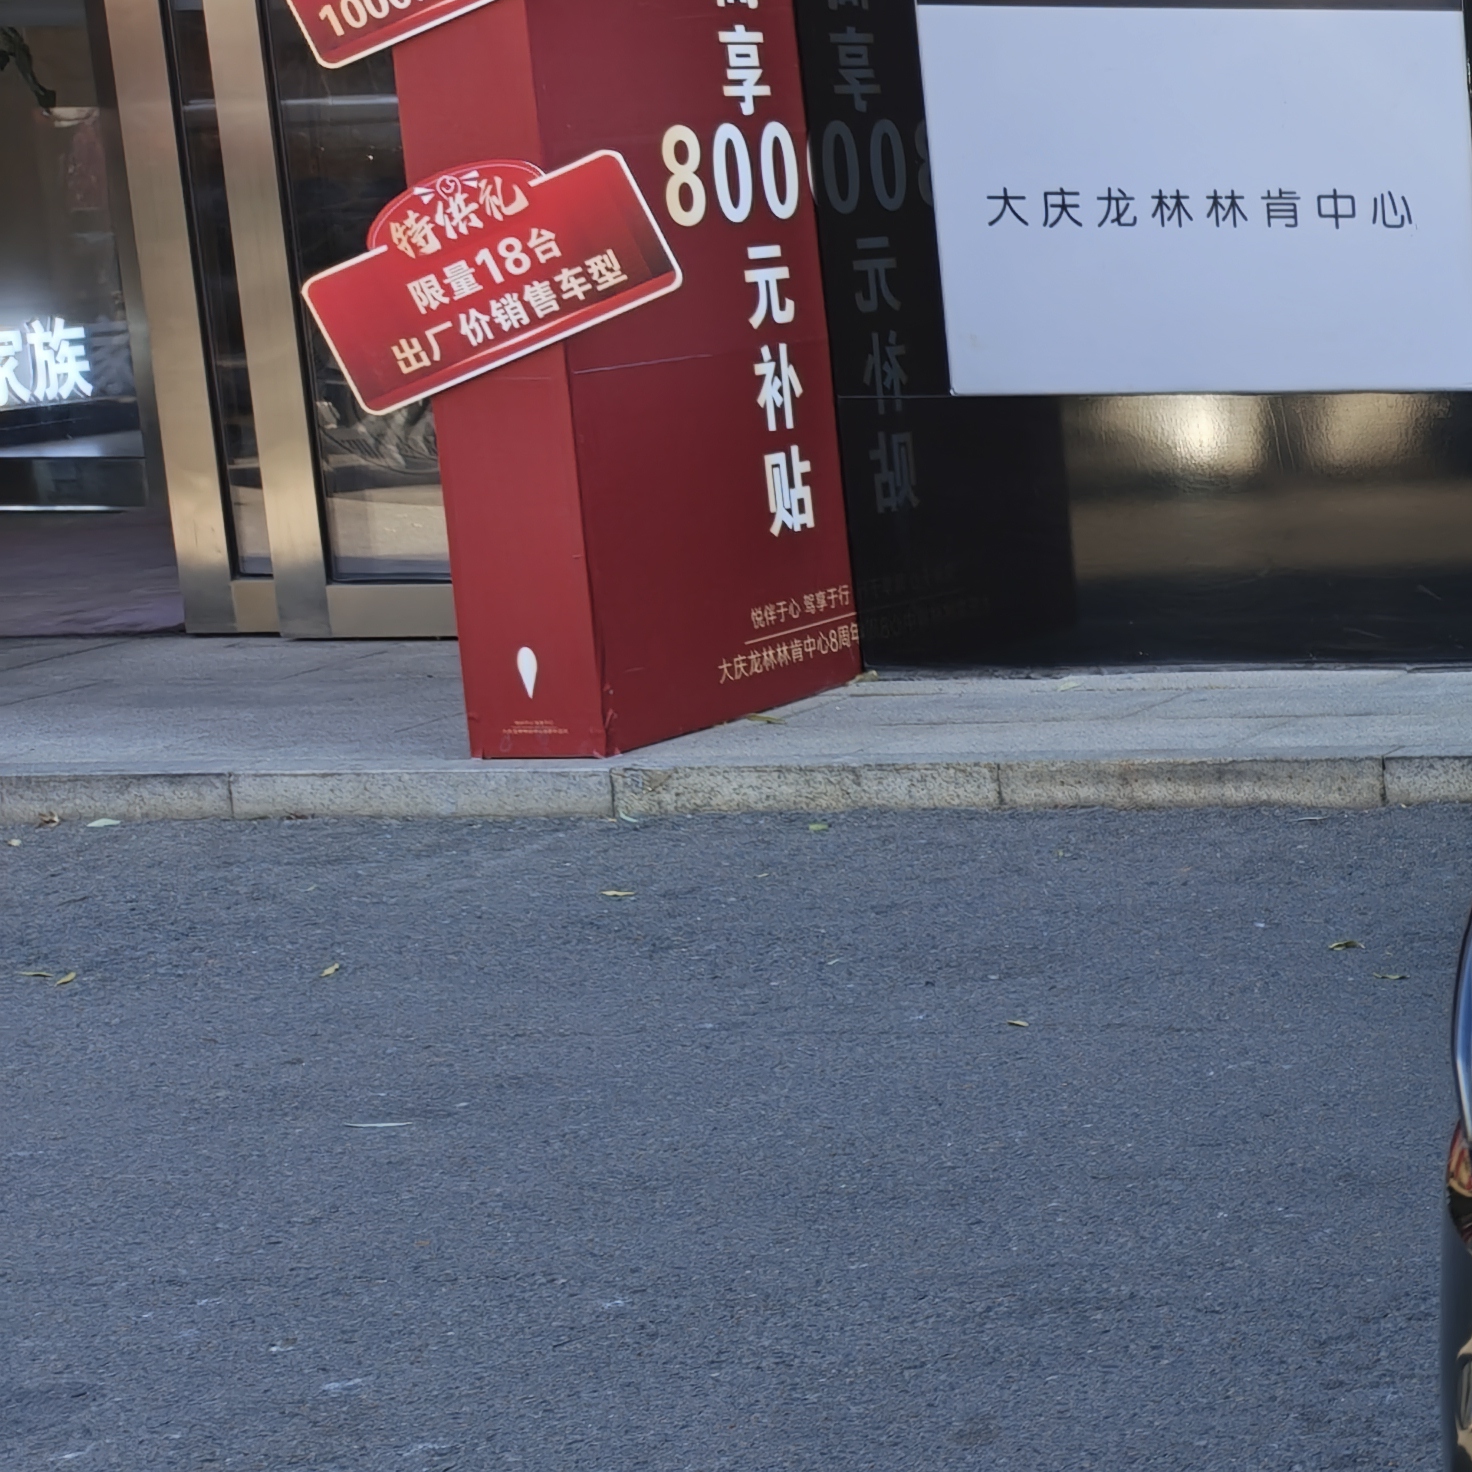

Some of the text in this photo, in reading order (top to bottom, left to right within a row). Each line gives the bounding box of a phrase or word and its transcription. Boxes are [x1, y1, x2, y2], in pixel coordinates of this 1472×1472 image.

[390, 175, 529, 260] 特供礼
[986, 187, 1414, 230] 大庆龙林林肯中心
[391, 248, 627, 375] 出厂价销售车型
[406, 227, 563, 315] 限量18台
[751, 597, 800, 629] 悦伴于心
[803, 585, 850, 615] 驾享于行
